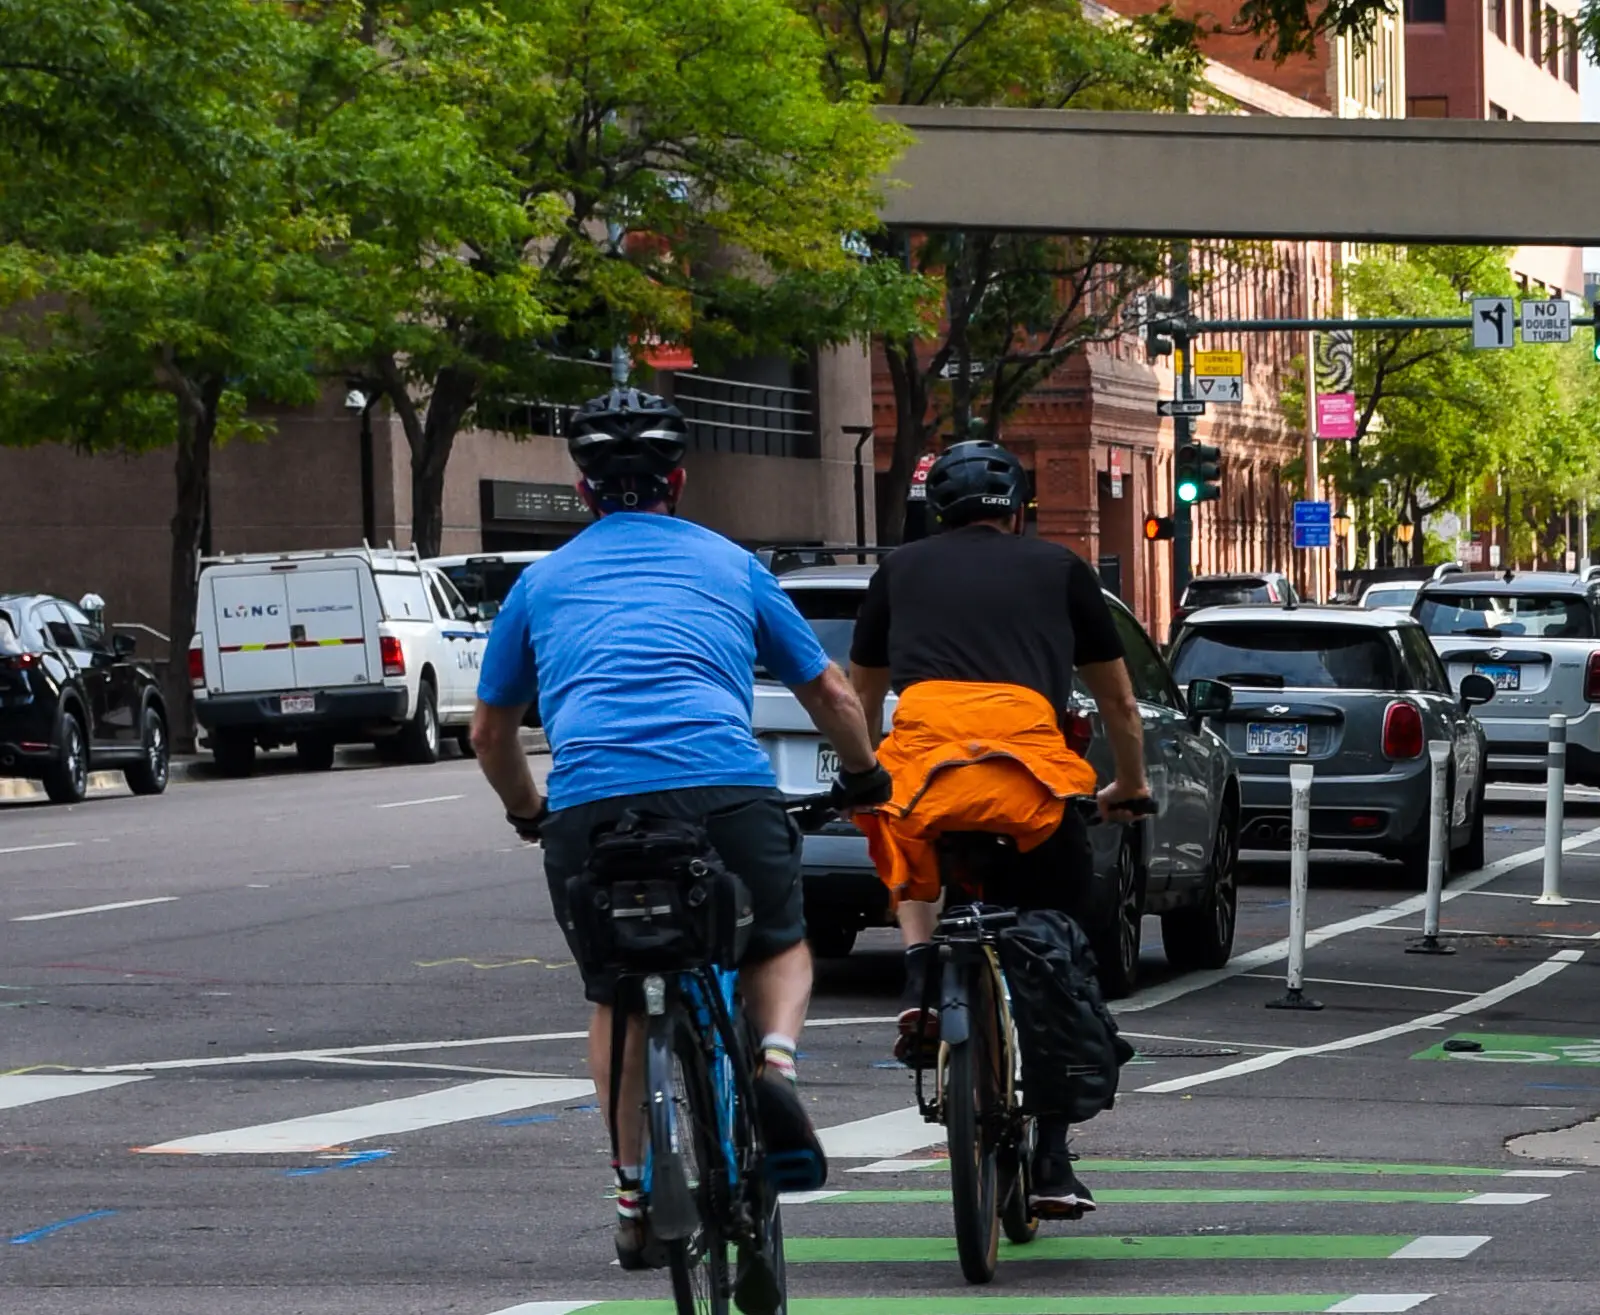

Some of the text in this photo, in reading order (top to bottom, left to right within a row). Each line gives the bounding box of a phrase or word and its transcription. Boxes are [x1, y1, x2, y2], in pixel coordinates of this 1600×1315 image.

[1534, 303, 1557, 317] NO
[1525, 319, 1567, 329] DOUBLE
[1532, 331, 1562, 341] TURN
[1217, 384, 1228, 392] TO
[981, 496, 1011, 506] GIRO
